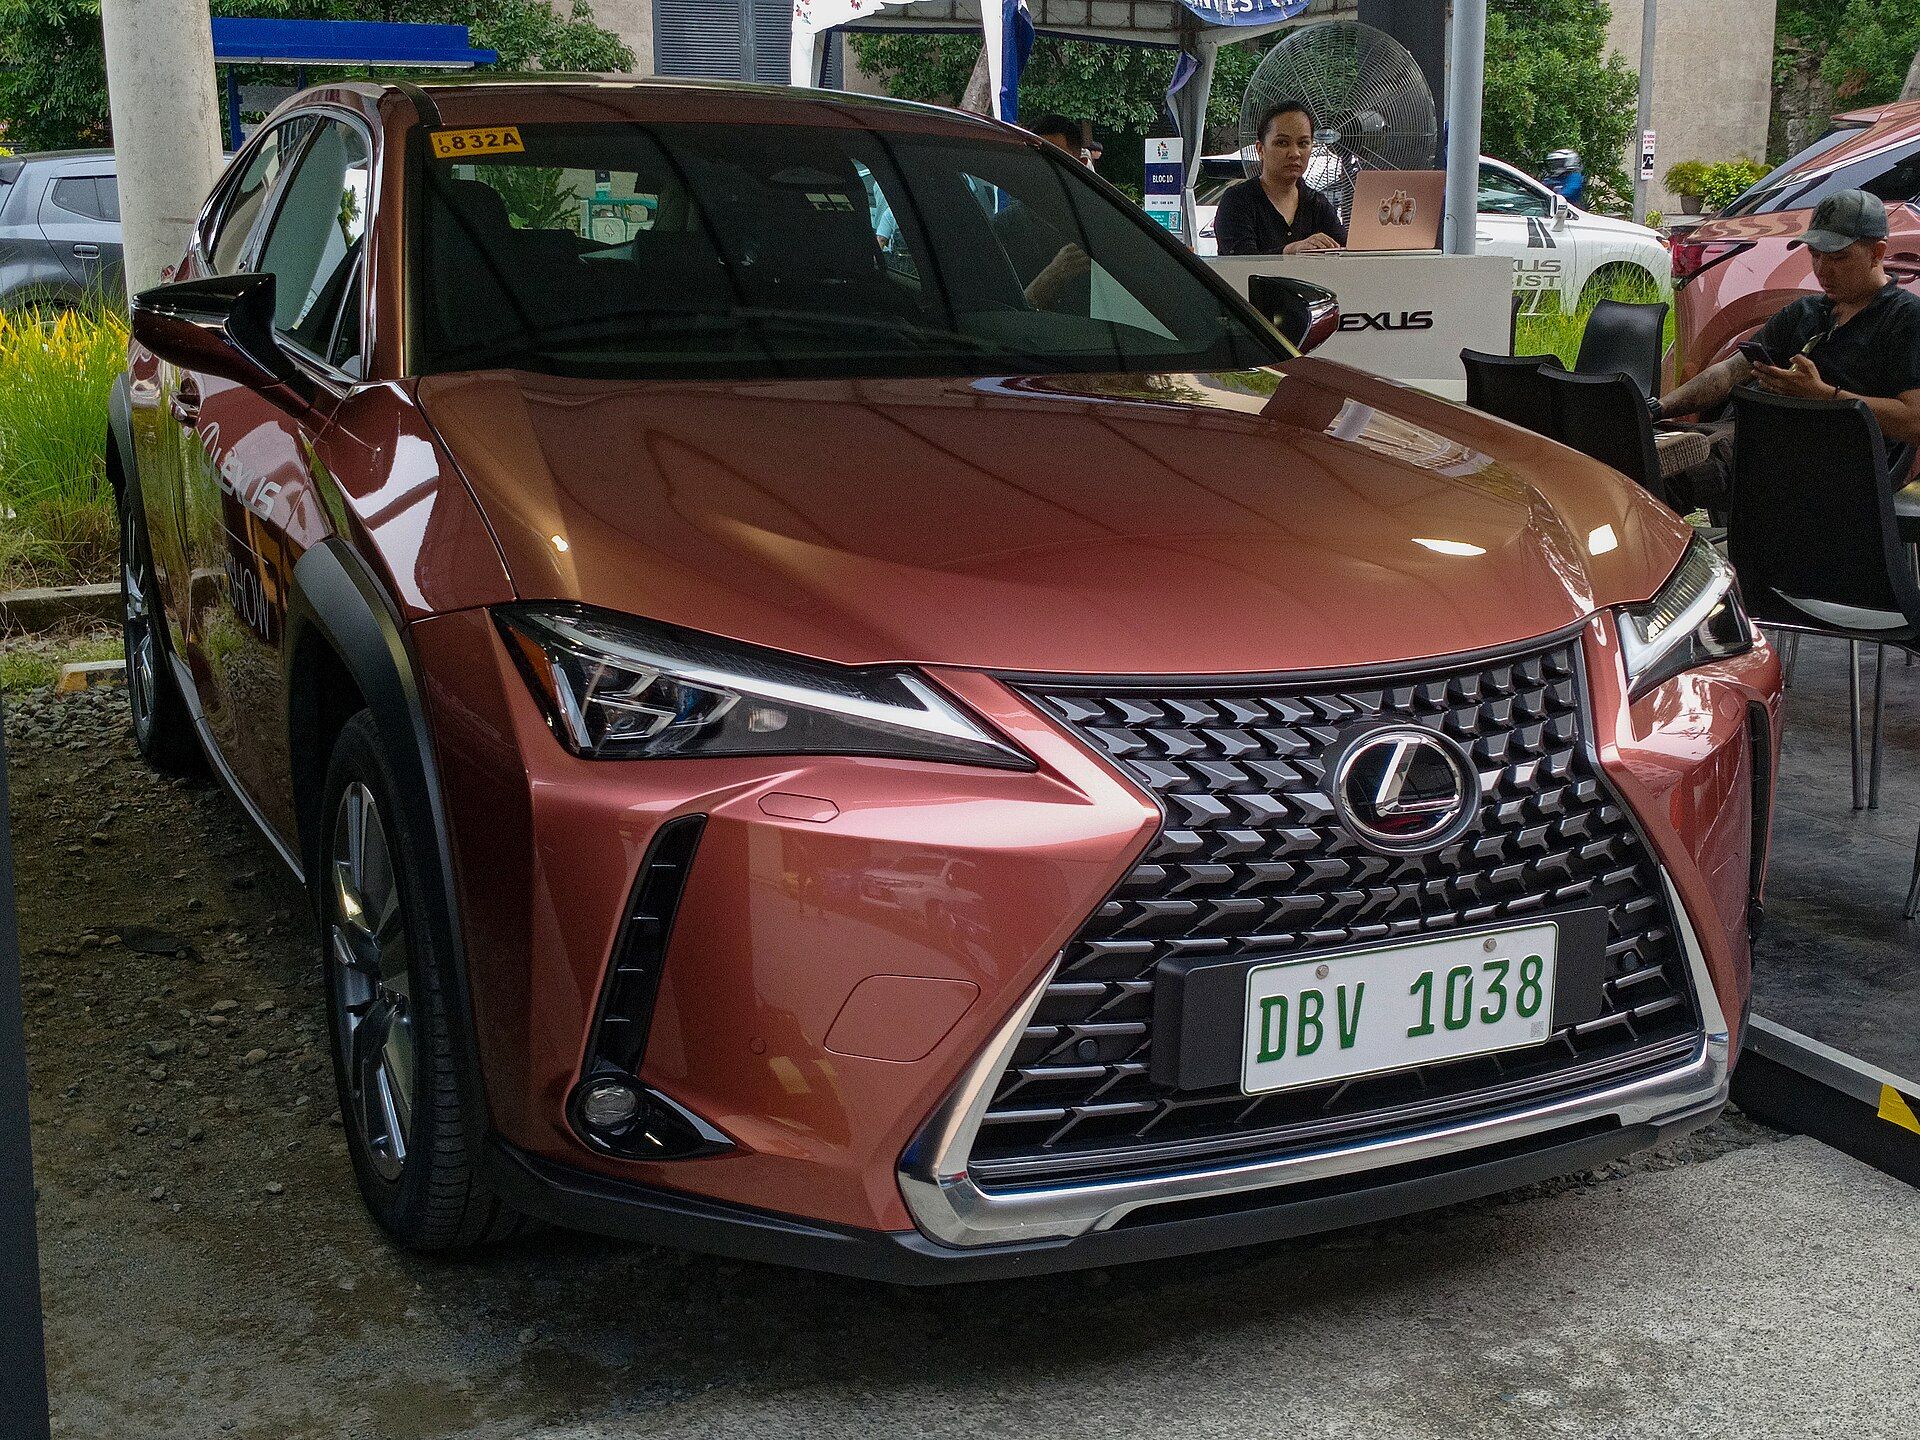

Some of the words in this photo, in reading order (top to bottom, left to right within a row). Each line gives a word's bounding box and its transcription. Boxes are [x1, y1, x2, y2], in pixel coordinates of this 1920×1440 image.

[1512, 275, 1561, 287] IST
[1337, 310, 1434, 332] EXUS
[1256, 981, 1366, 1064] DBV
[1406, 954, 1544, 1038] 1038
